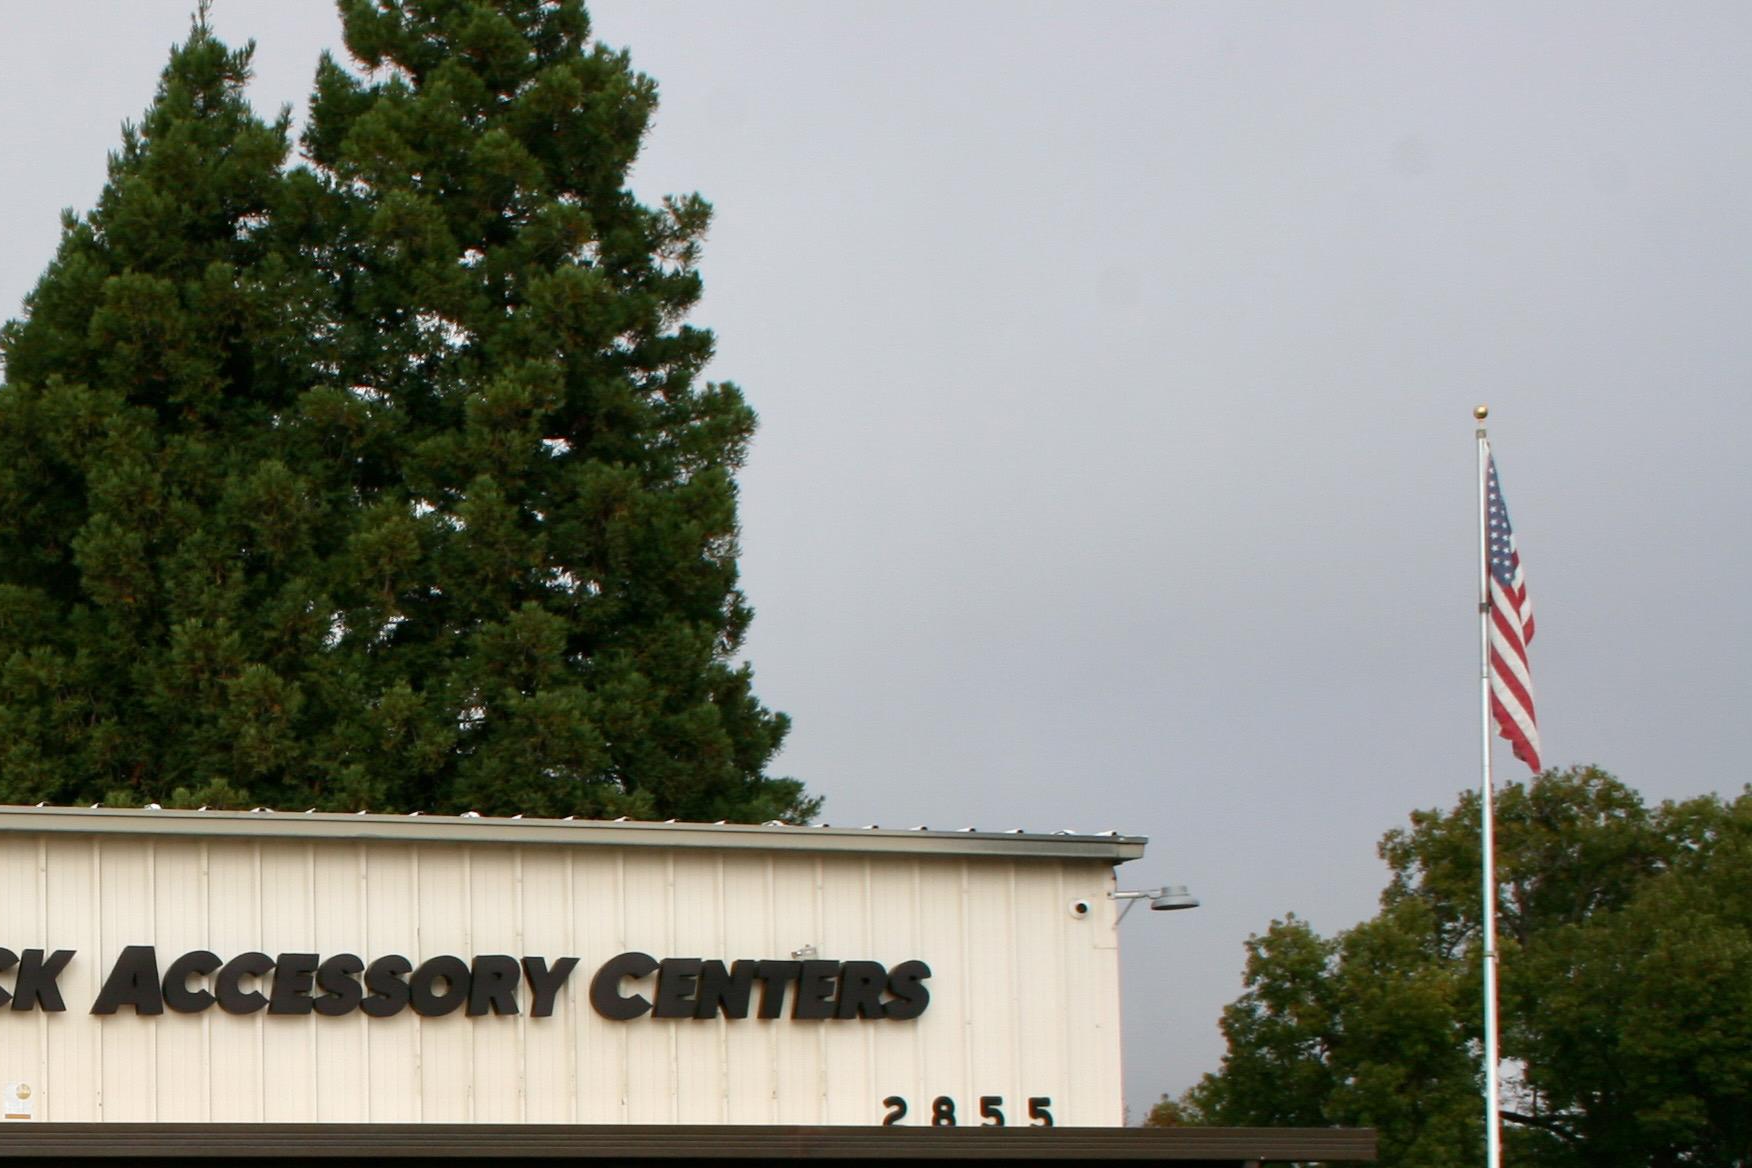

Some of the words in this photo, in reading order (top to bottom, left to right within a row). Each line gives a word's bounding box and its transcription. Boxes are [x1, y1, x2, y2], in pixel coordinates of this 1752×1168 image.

[89, 945, 580, 1018] ACCESSORY
[589, 952, 933, 1022] CENTERS
[881, 1095, 1055, 1127] 2855
